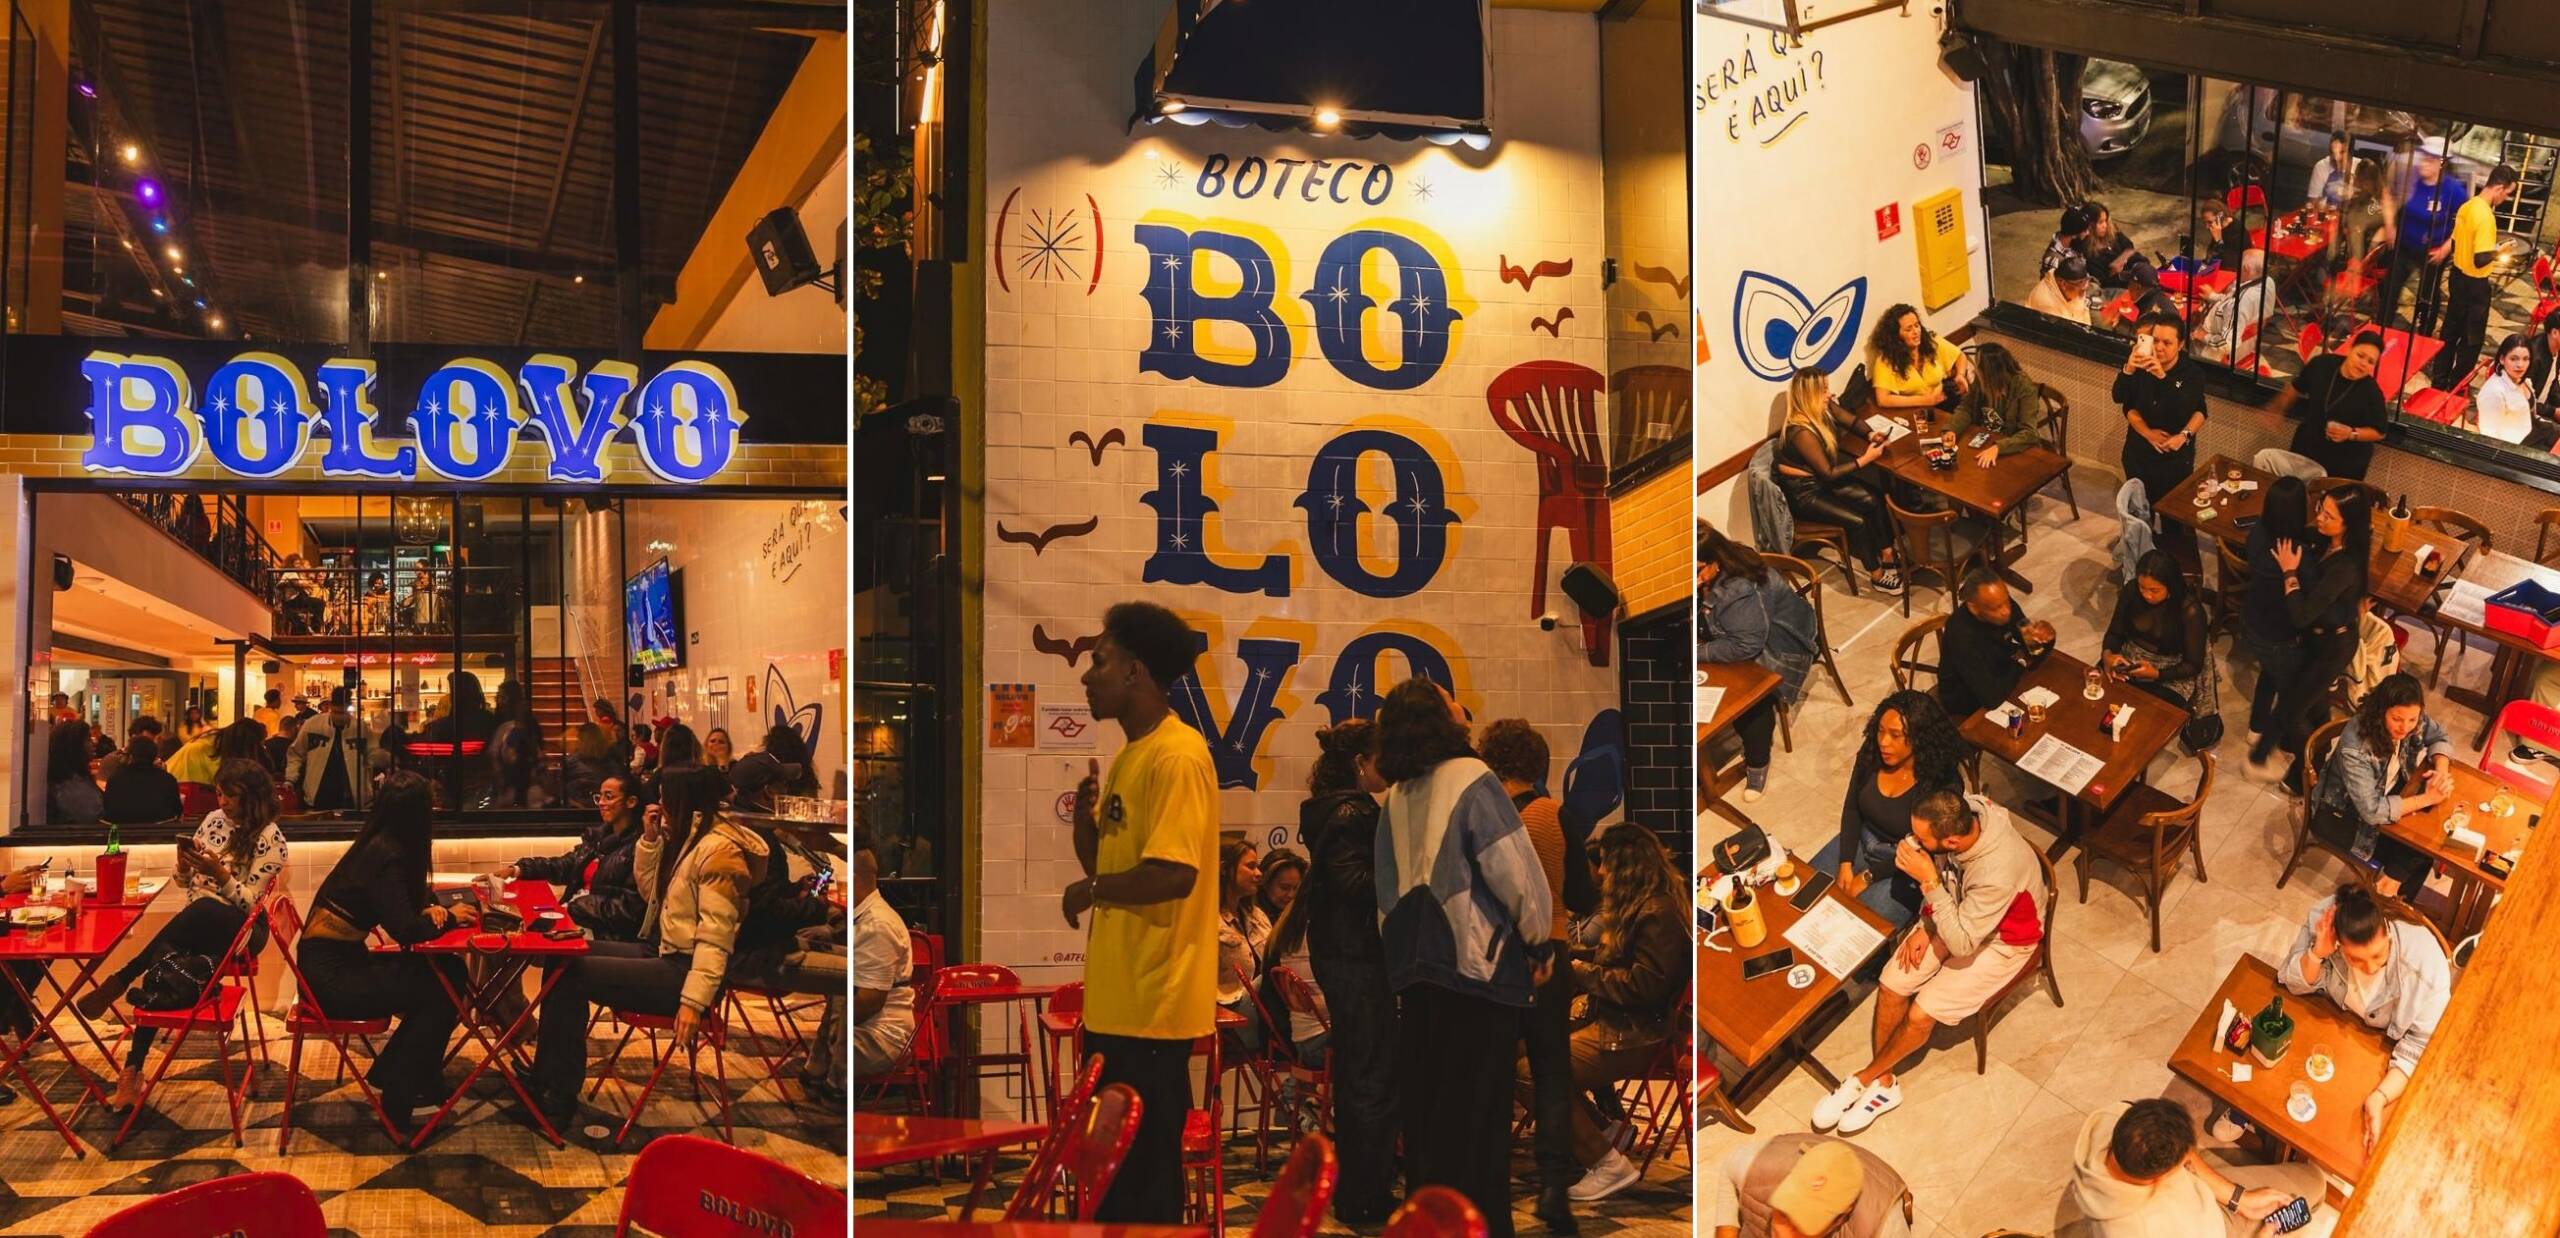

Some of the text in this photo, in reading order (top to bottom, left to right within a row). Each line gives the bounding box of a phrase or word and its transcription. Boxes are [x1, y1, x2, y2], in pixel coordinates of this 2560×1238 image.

[1196, 152, 1394, 206] BOTECO
[1728, 99, 1741, 140] É
[1134, 222, 1465, 391] BO
[81, 350, 749, 483] BOLOVO
[1139, 422, 1464, 599] LO
